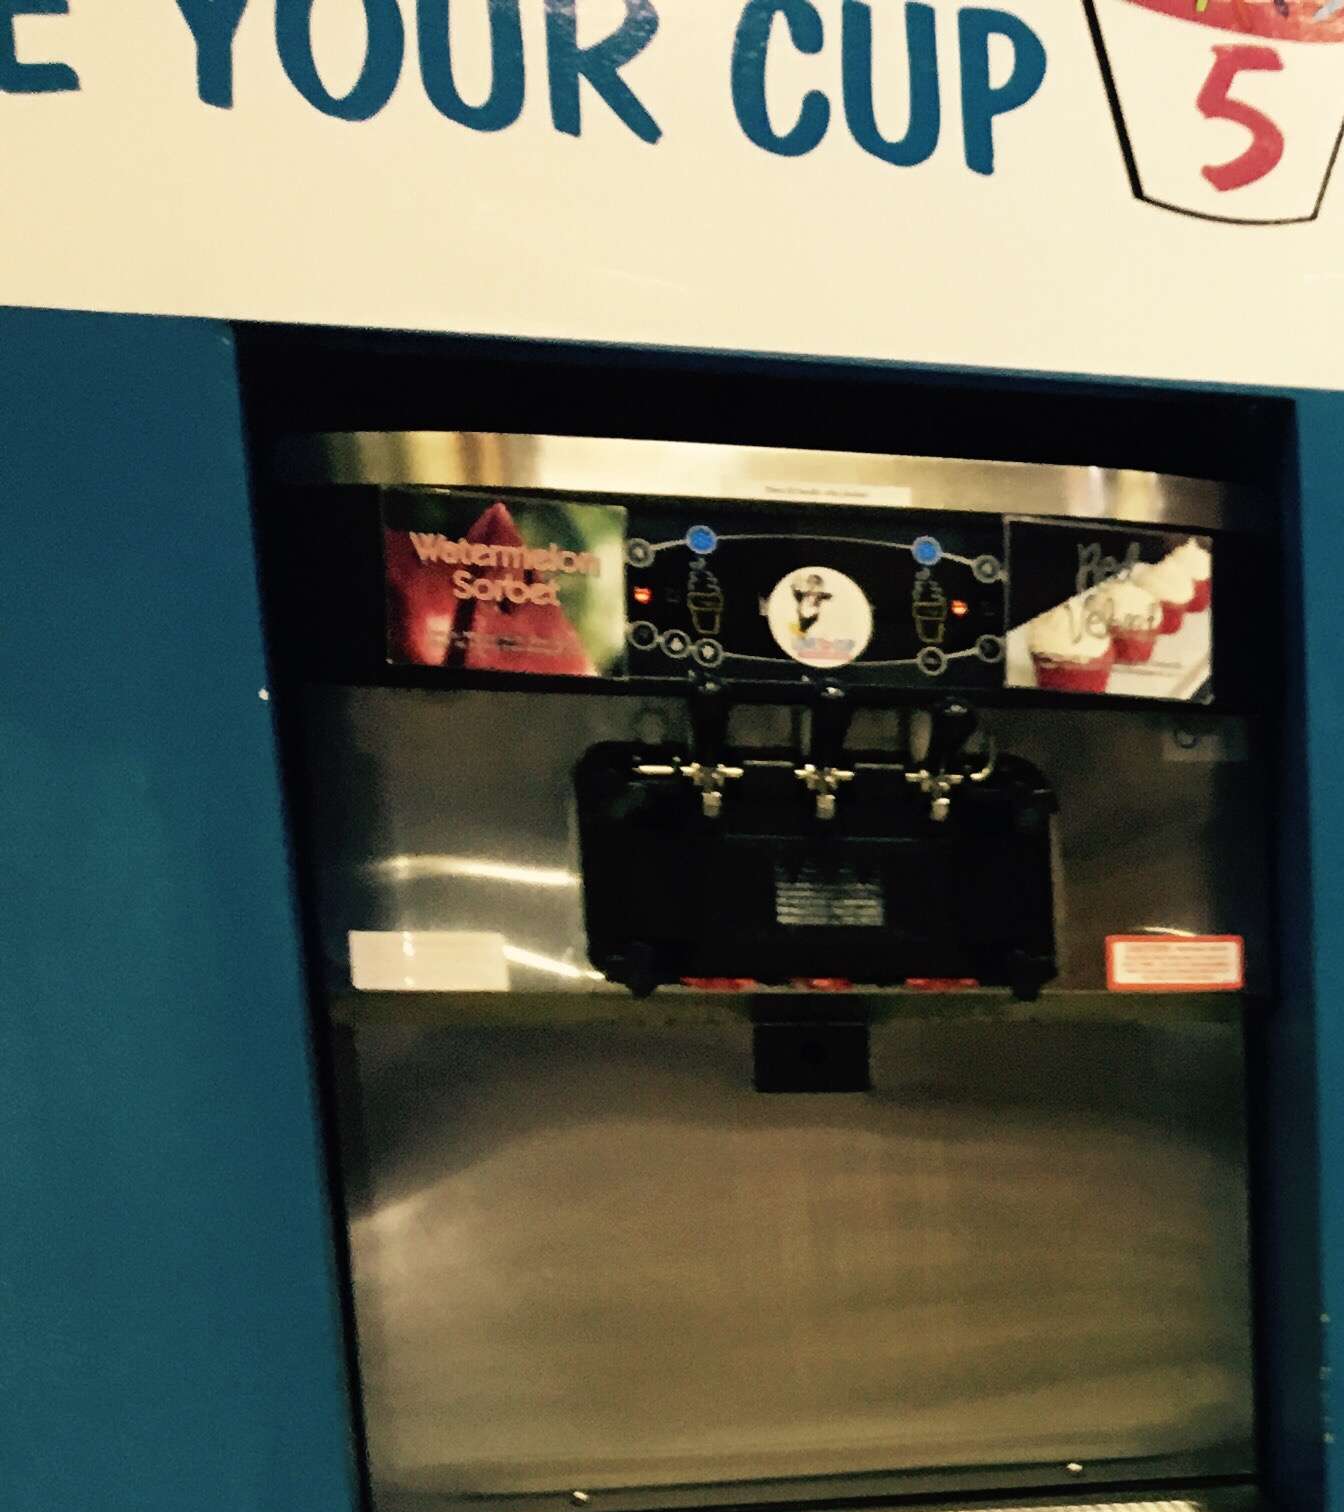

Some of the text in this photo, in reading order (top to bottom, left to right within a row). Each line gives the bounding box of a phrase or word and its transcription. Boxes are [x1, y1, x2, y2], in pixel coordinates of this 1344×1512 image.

[176, 0, 663, 145] YOUR
[731, 0, 1048, 177] CUP
[1196, 45, 1286, 192] 5
[409, 531, 600, 576] Watermelon
[453, 569, 561, 607] Sorbet
